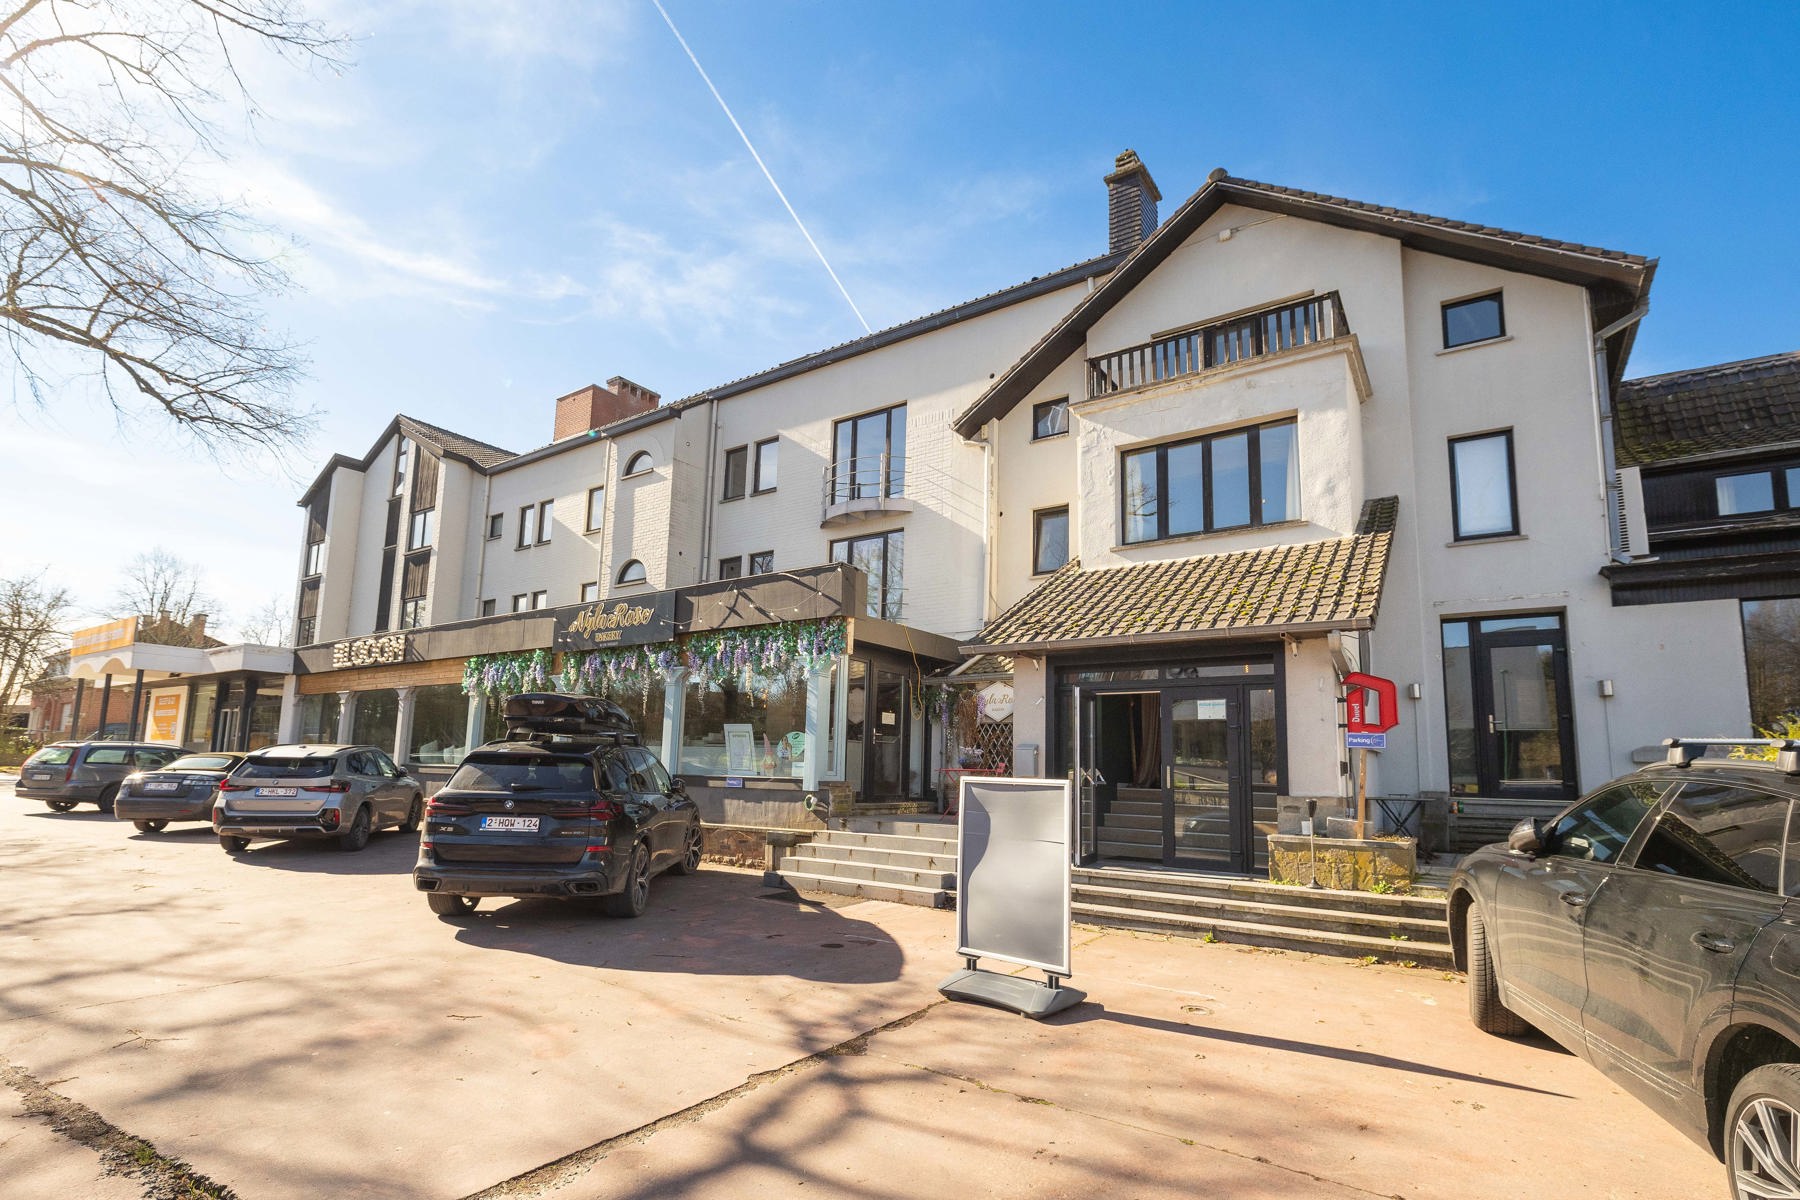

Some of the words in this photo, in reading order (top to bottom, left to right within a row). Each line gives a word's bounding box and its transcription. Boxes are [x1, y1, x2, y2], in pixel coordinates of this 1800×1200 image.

[608, 602, 655, 628] Rose
[1351, 703, 1361, 723] Duvel
[1348, 736, 1371, 745] Parking
